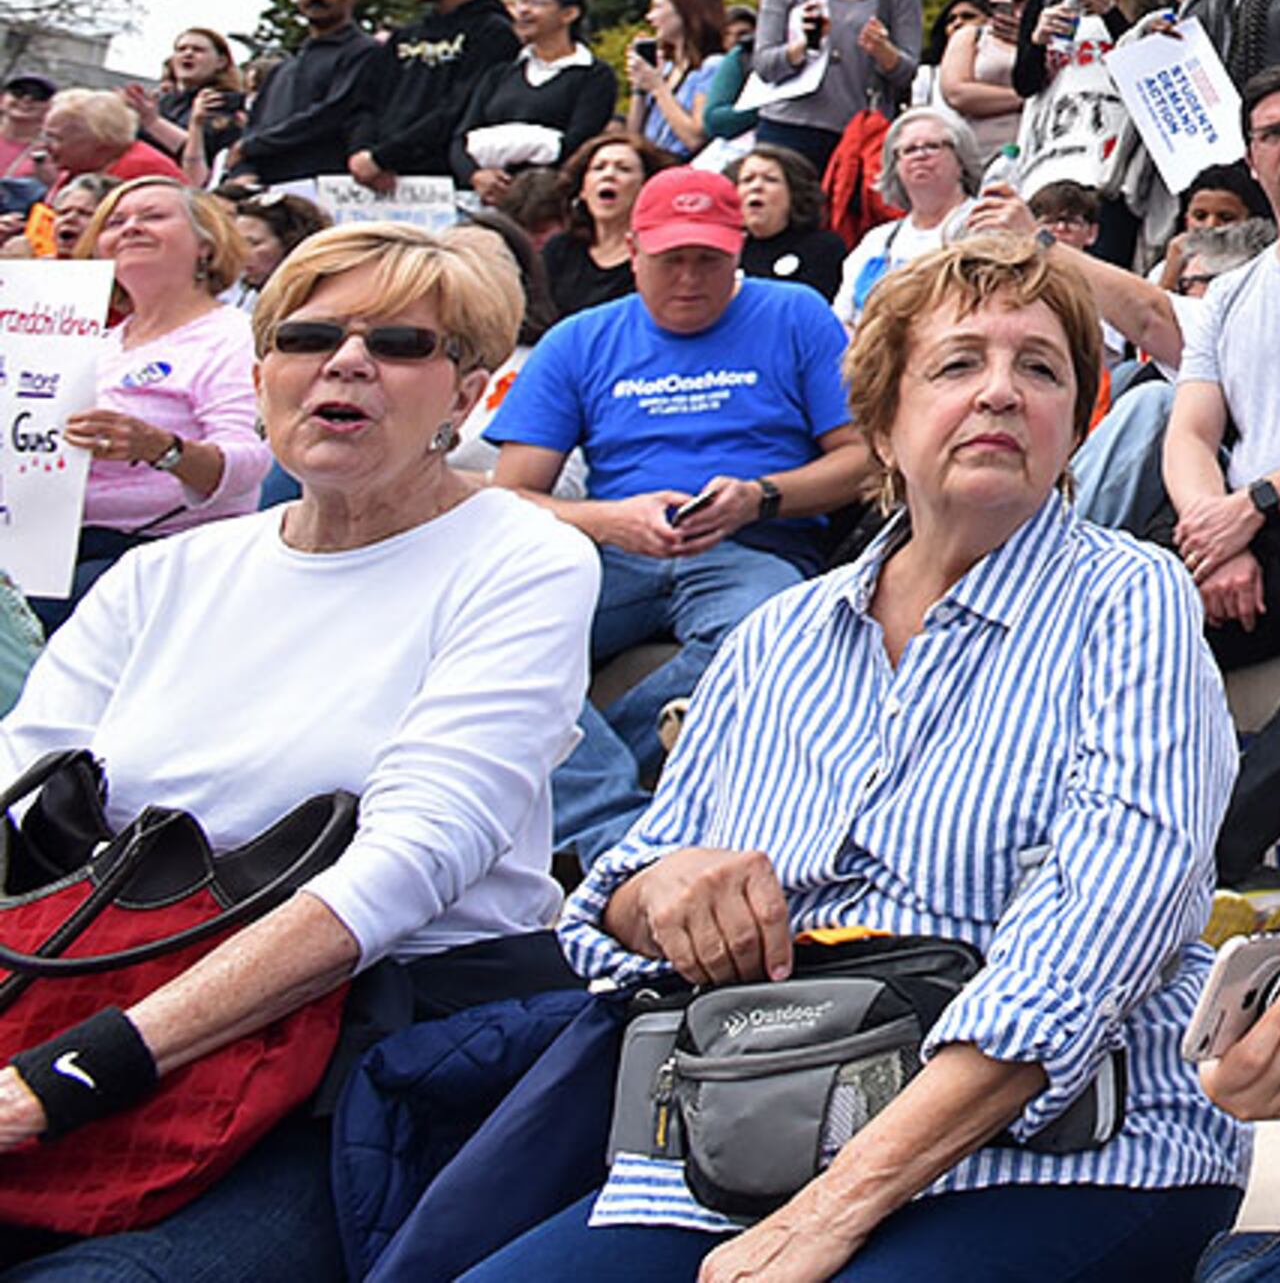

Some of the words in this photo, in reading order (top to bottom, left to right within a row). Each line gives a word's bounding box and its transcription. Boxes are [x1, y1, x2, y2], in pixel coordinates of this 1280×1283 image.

[1144, 77, 1181, 134] ACTION
[1157, 70, 1198, 136] DEMAND
[1170, 65, 1218, 144] STUDENTS
[612, 370, 758, 399] #NotOneMore
